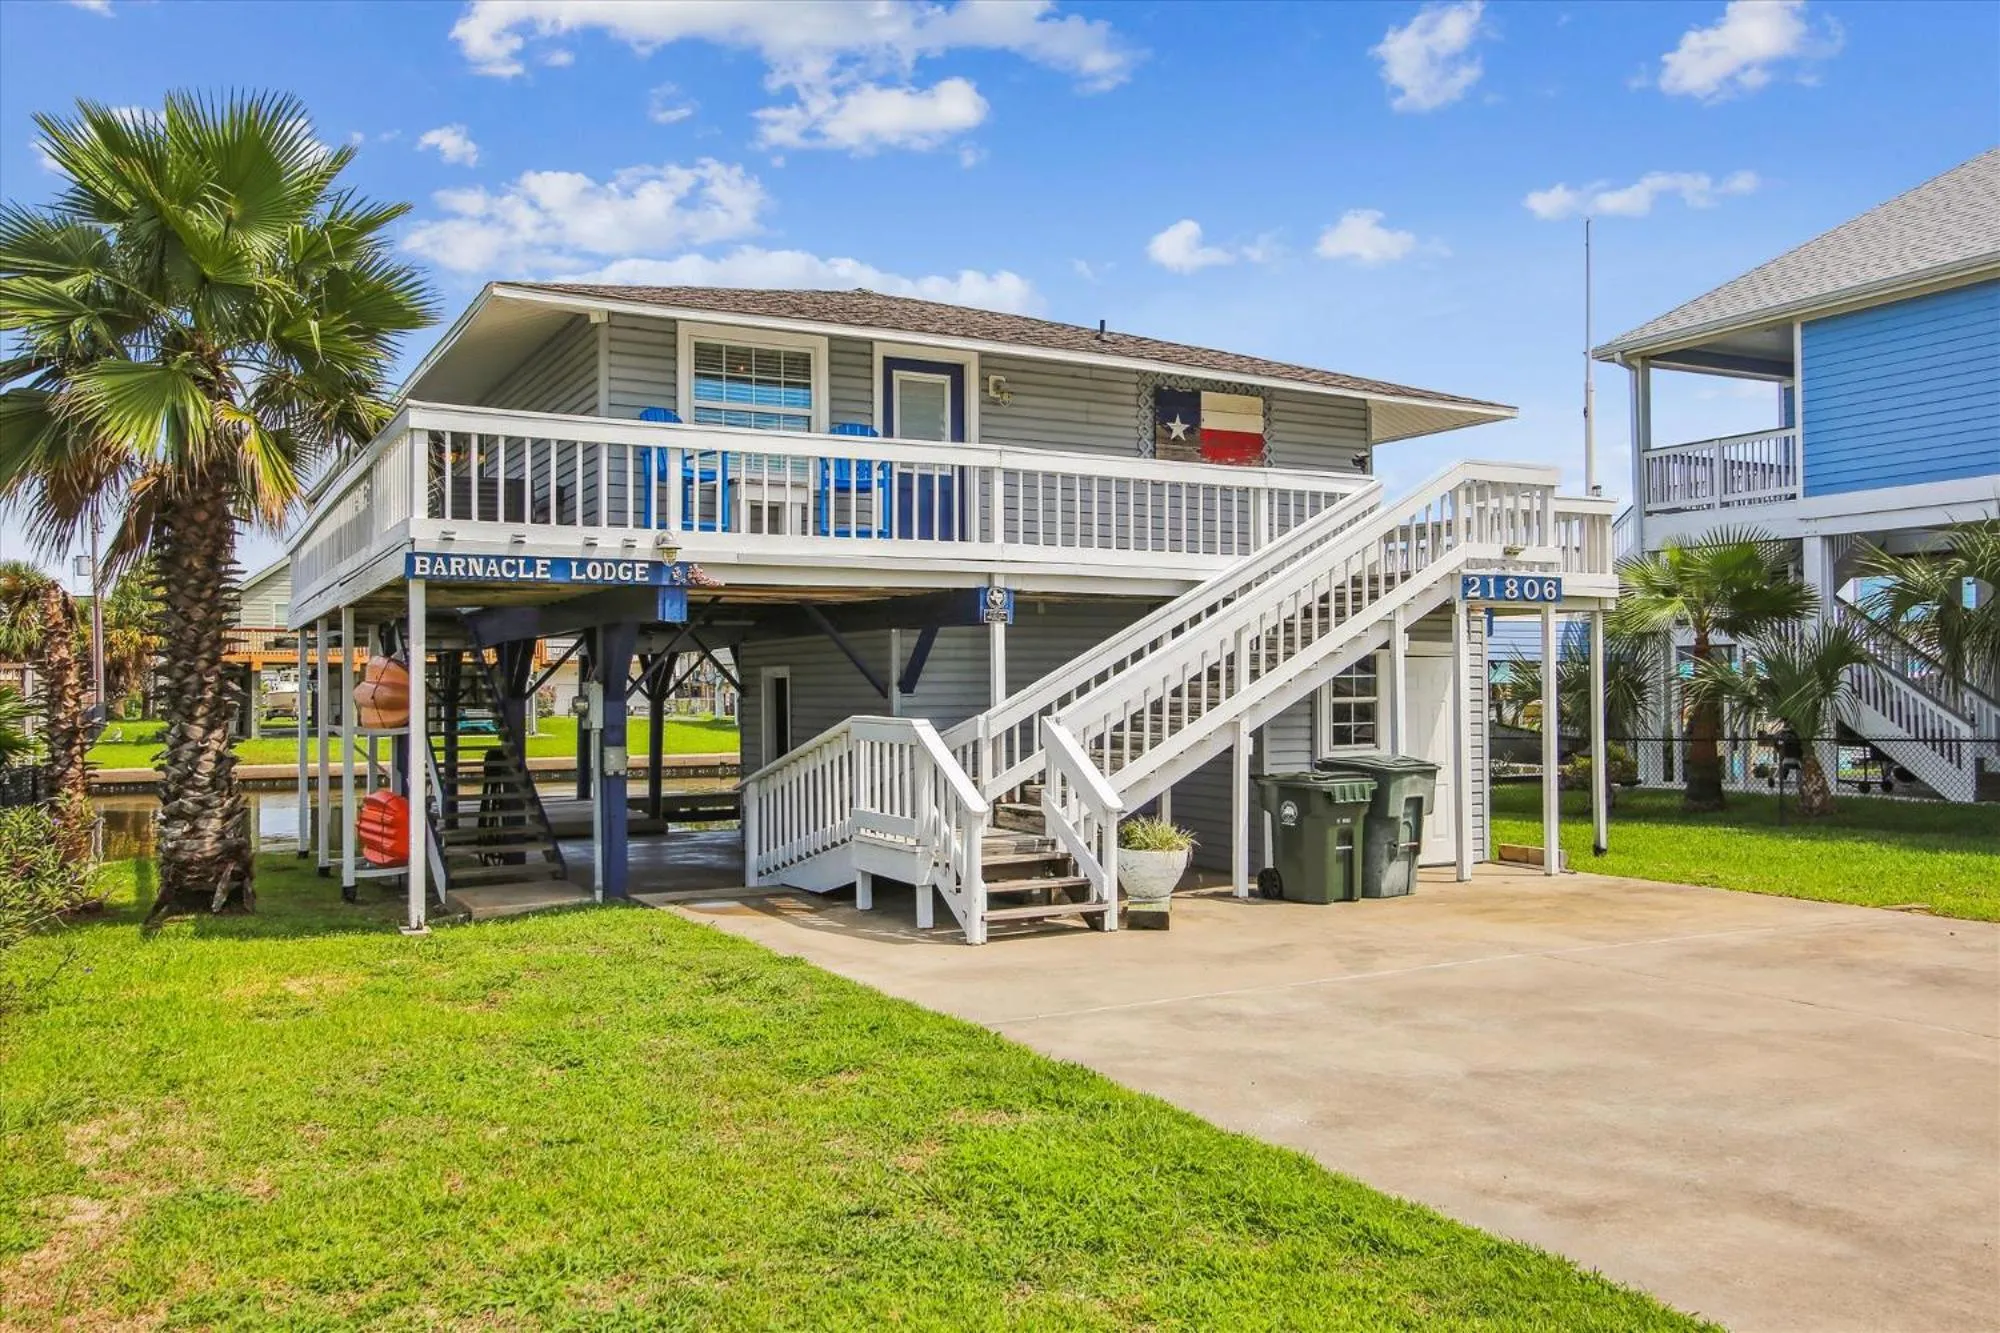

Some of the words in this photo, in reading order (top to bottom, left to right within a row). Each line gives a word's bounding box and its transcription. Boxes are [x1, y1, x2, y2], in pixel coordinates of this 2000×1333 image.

[414, 555, 551, 579] BARNACLE
[570, 560, 650, 582] LODGE
[1466, 576, 1557, 600] 21806
